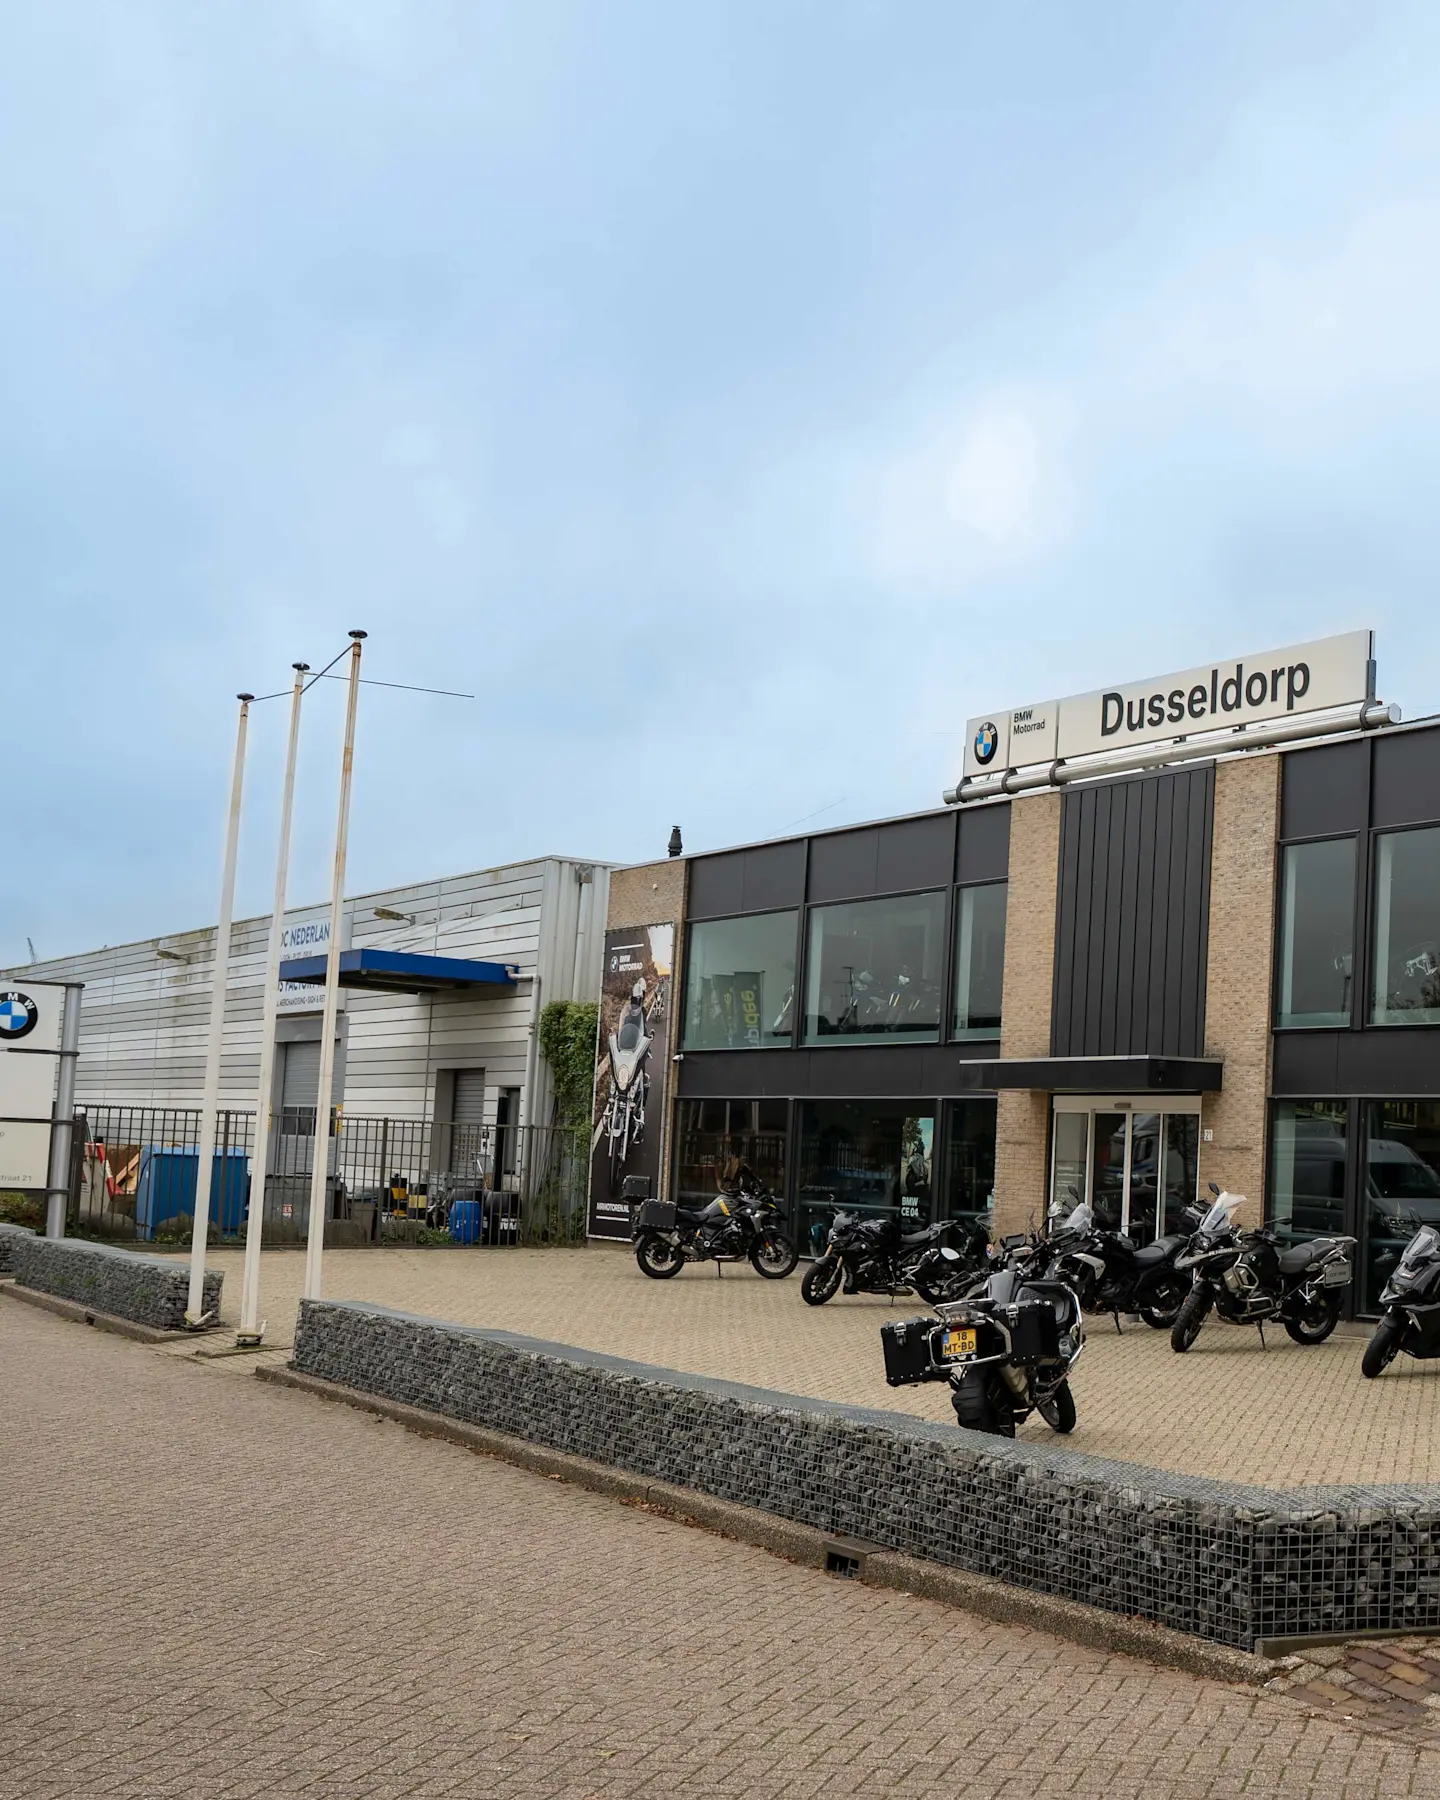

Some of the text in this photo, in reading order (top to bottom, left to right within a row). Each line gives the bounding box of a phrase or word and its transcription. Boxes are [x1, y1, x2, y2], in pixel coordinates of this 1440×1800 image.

[1101, 662, 1310, 737] Dusseldorp
[1013, 709, 1033, 723] BMW
[1013, 718, 1046, 736] Motorrad
[290, 922, 331, 947] NEDERLAN
[619, 954, 631, 963] BMW
[901, 1196, 919, 1206] BMW
[901, 1207, 919, 1217] CE 04
[957, 1331, 968, 1341] 18
[944, 1340, 975, 1354] MT-BD
